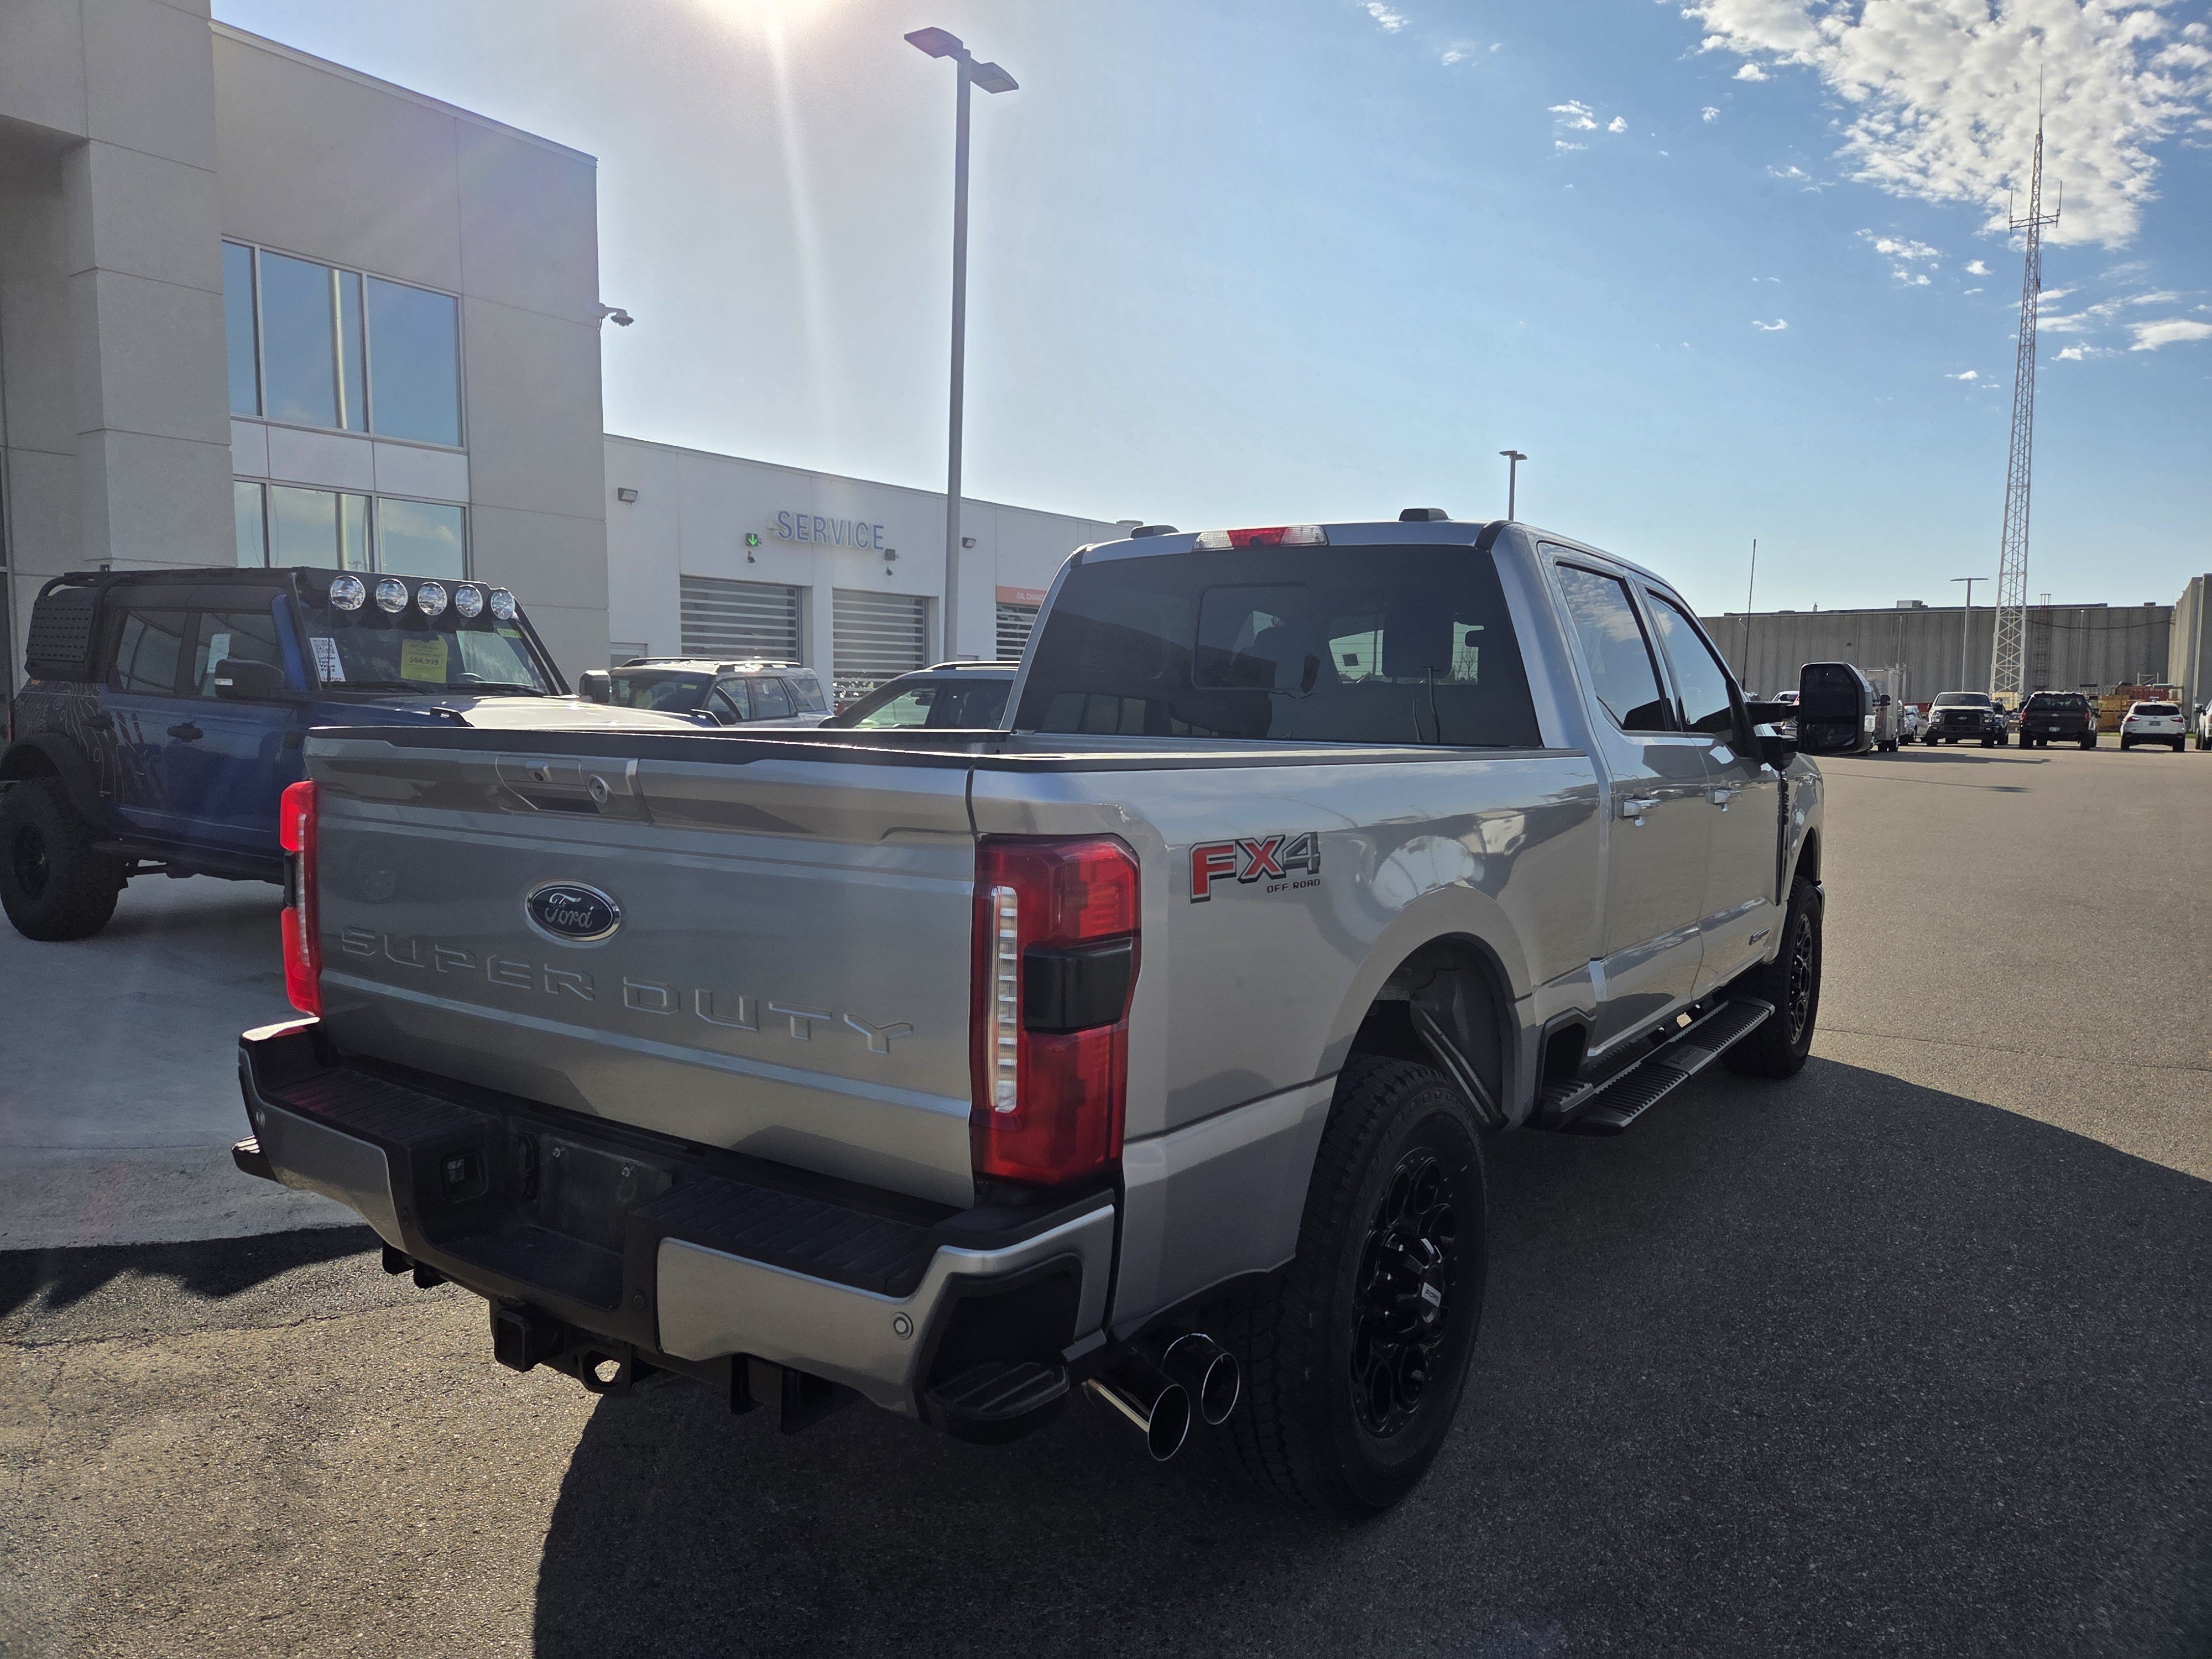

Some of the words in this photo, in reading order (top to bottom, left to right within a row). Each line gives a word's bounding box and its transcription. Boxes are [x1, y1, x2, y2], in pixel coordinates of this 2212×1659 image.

[777, 510, 884, 550] SERVICE
[1026, 593, 1044, 601] CHANG
[409, 656, 439, 665] $64,999
[1189, 831, 1321, 904] FX4
[1267, 884, 1289, 893] OFF
[1293, 879, 1320, 889] ROAD
[545, 893, 594, 928] Ford
[341, 926, 594, 1001] SUPER
[623, 976, 914, 1054] DUTY
